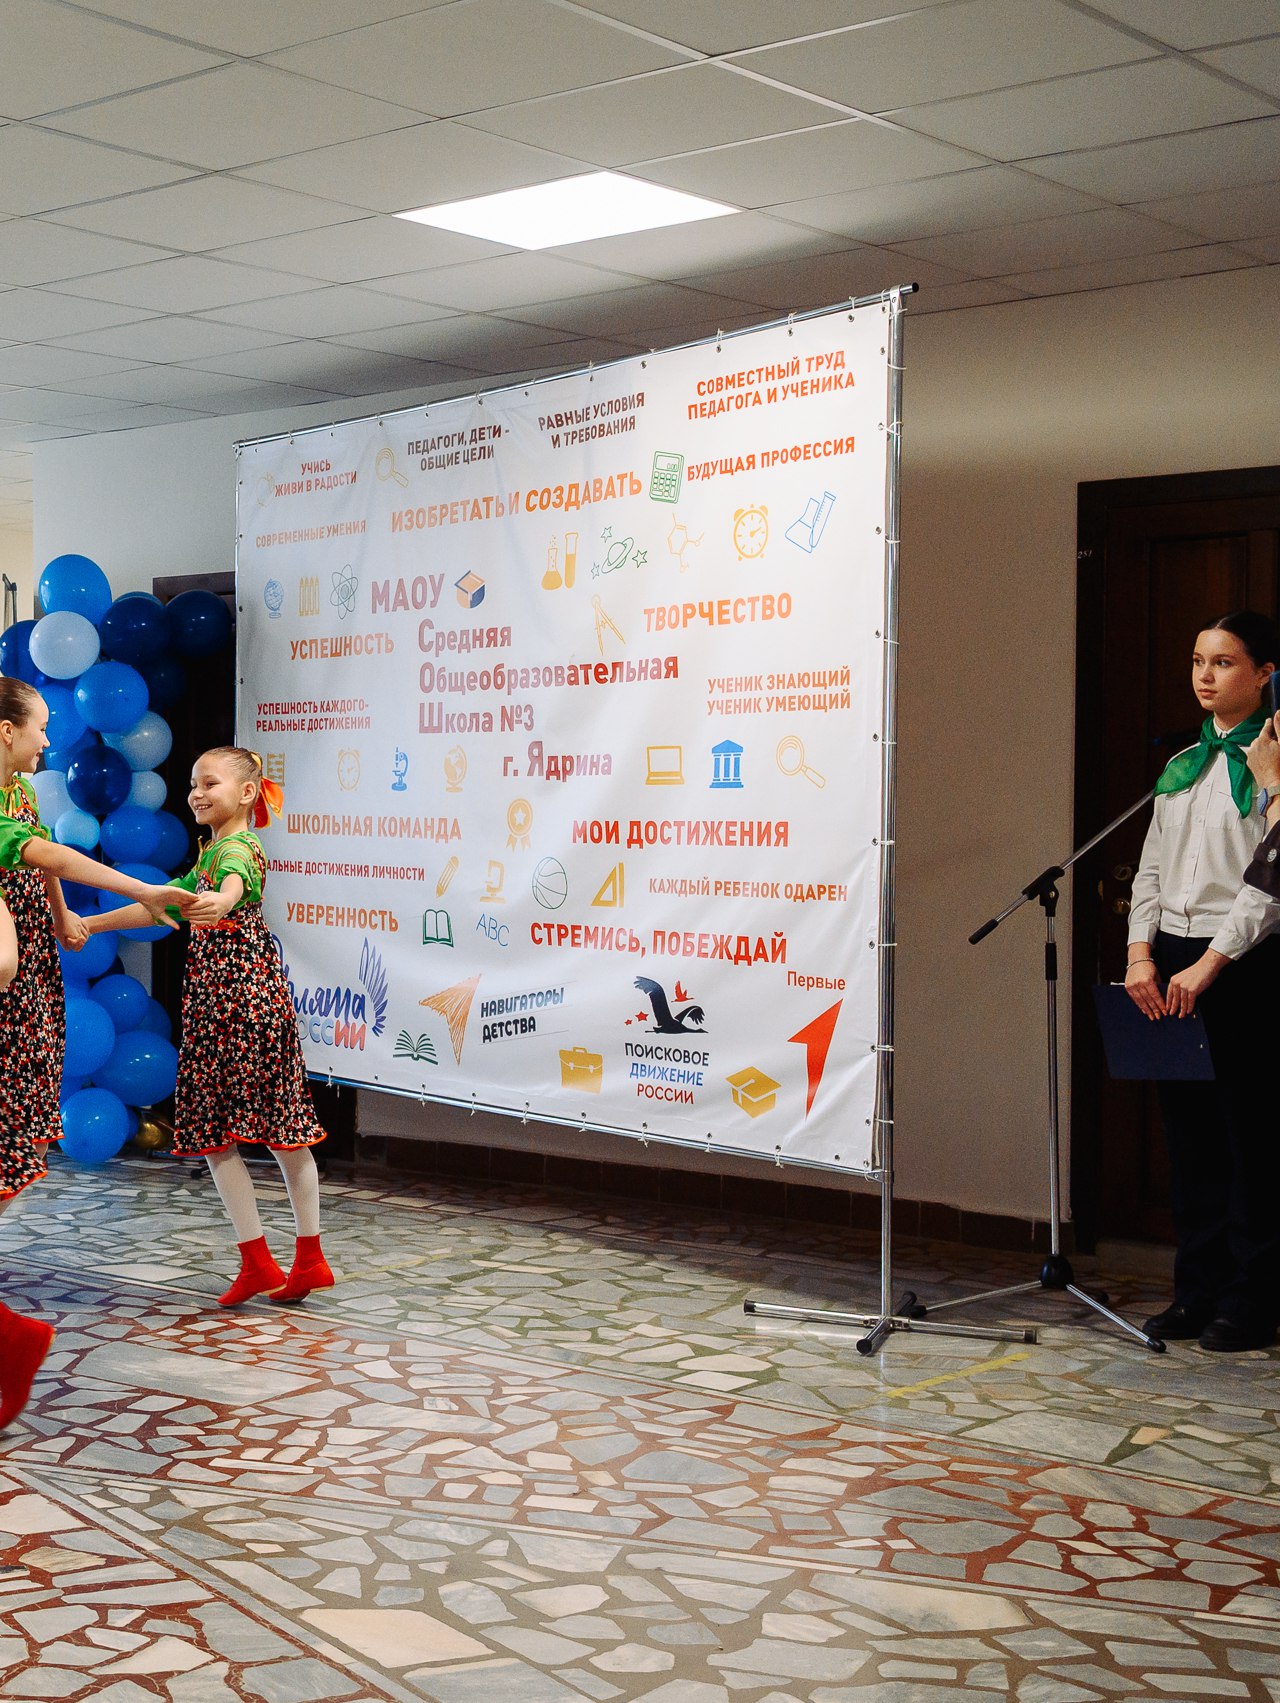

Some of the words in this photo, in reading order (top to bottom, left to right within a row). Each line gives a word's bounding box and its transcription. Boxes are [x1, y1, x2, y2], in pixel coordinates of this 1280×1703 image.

[697, 357, 801, 396] СОВМЕСТНЫЙ
[806, 350, 845, 375] ТРУД
[687, 391, 762, 420] ПЕДАГОГА
[768, 386, 777, 402] И
[781, 371, 856, 401] УЧЕНИКА
[538, 407, 591, 432] РАВНЫЕ
[593, 391, 645, 420] УСЛОВИЯ
[407, 429, 468, 456] ПЕДАГОГИ,
[468, 425, 502, 447] ДЕТИ
[551, 434, 561, 449] И
[563, 415, 636, 447] ТРЕБОВАНИЯ
[301, 459, 331, 476] УЧИСЬ
[420, 452, 460, 472] ОБЩИЕ
[463, 446, 494, 467] ЦЕЛИ
[687, 453, 756, 482] БУДУЩАЯ
[761, 437, 855, 468] ПРОФЕССИЯ
[275, 481, 304, 497] ЖИВИ
[306, 479, 312, 492] В
[315, 471, 357, 491] РАДОСТИ
[391, 495, 506, 533] ИЗОБРЕТАТЬ
[508, 491, 520, 515] И
[525, 471, 642, 514] СОЗДАВАТЬ
[256, 526, 325, 548] СОВРЕМЕННЫЕ
[326, 520, 366, 538] УМЕНИЯ
[371, 573, 445, 614] МАОУ
[643, 592, 792, 633] ТВОРЧЕСТВО
[290, 632, 395, 661] УСПЕШНОСТЬ
[418, 618, 512, 657] Средняя
[419, 656, 679, 696] Общеобразовательная
[707, 674, 763, 695] УЧЕНИК
[766, 665, 851, 691] ЗНАЮЩИЙ
[257, 701, 318, 716] УСПЕШНОСТЬ
[418, 702, 493, 734] Школа
[500, 704, 535, 732] №3
[707, 697, 762, 717] УЧЕНИК
[766, 689, 851, 713] УМЕЮЩИЙ
[256, 718, 305, 732] РЕАЛЬНЫЕ
[307, 716, 371, 733] ДОСТИЖЕНИЯ
[503, 754, 519, 777] г.
[527, 740, 612, 782] Ядрина
[287, 814, 372, 837] ШКОЛЬНАЯ
[377, 816, 462, 844] КОМАНДА
[572, 820, 620, 845] МОИ
[626, 820, 789, 849] ДОСТИЖЕНИЯ
[267, 859, 303, 874] АЛЬНЫЕ
[304, 861, 369, 878] ДОСТИЖЕНИЯ
[372, 865, 425, 881] ЛИЧНОСТИ
[649, 875, 710, 897] КАЖДЫЙ
[714, 881, 780, 900] РЕБЕНОК
[784, 883, 848, 903] ОДАРЕН
[287, 902, 399, 932] УВЕРЕННОСТЬ
[531, 921, 646, 958] СТРЕМИСЬ,
[652, 930, 787, 966] ПОБЕЖДАЙ
[787, 971, 846, 991] Первые
[480, 987, 565, 1018] НАВИГАТОРЫ
[297, 1016, 367, 1051] ОССИИ
[482, 1016, 536, 1043] ДЕТСТВА
[625, 1043, 710, 1067] ПОИСКОВОЕ
[630, 1062, 704, 1087] ДВИЖЕНИЕ
[637, 1083, 694, 1105] РОССИИ
